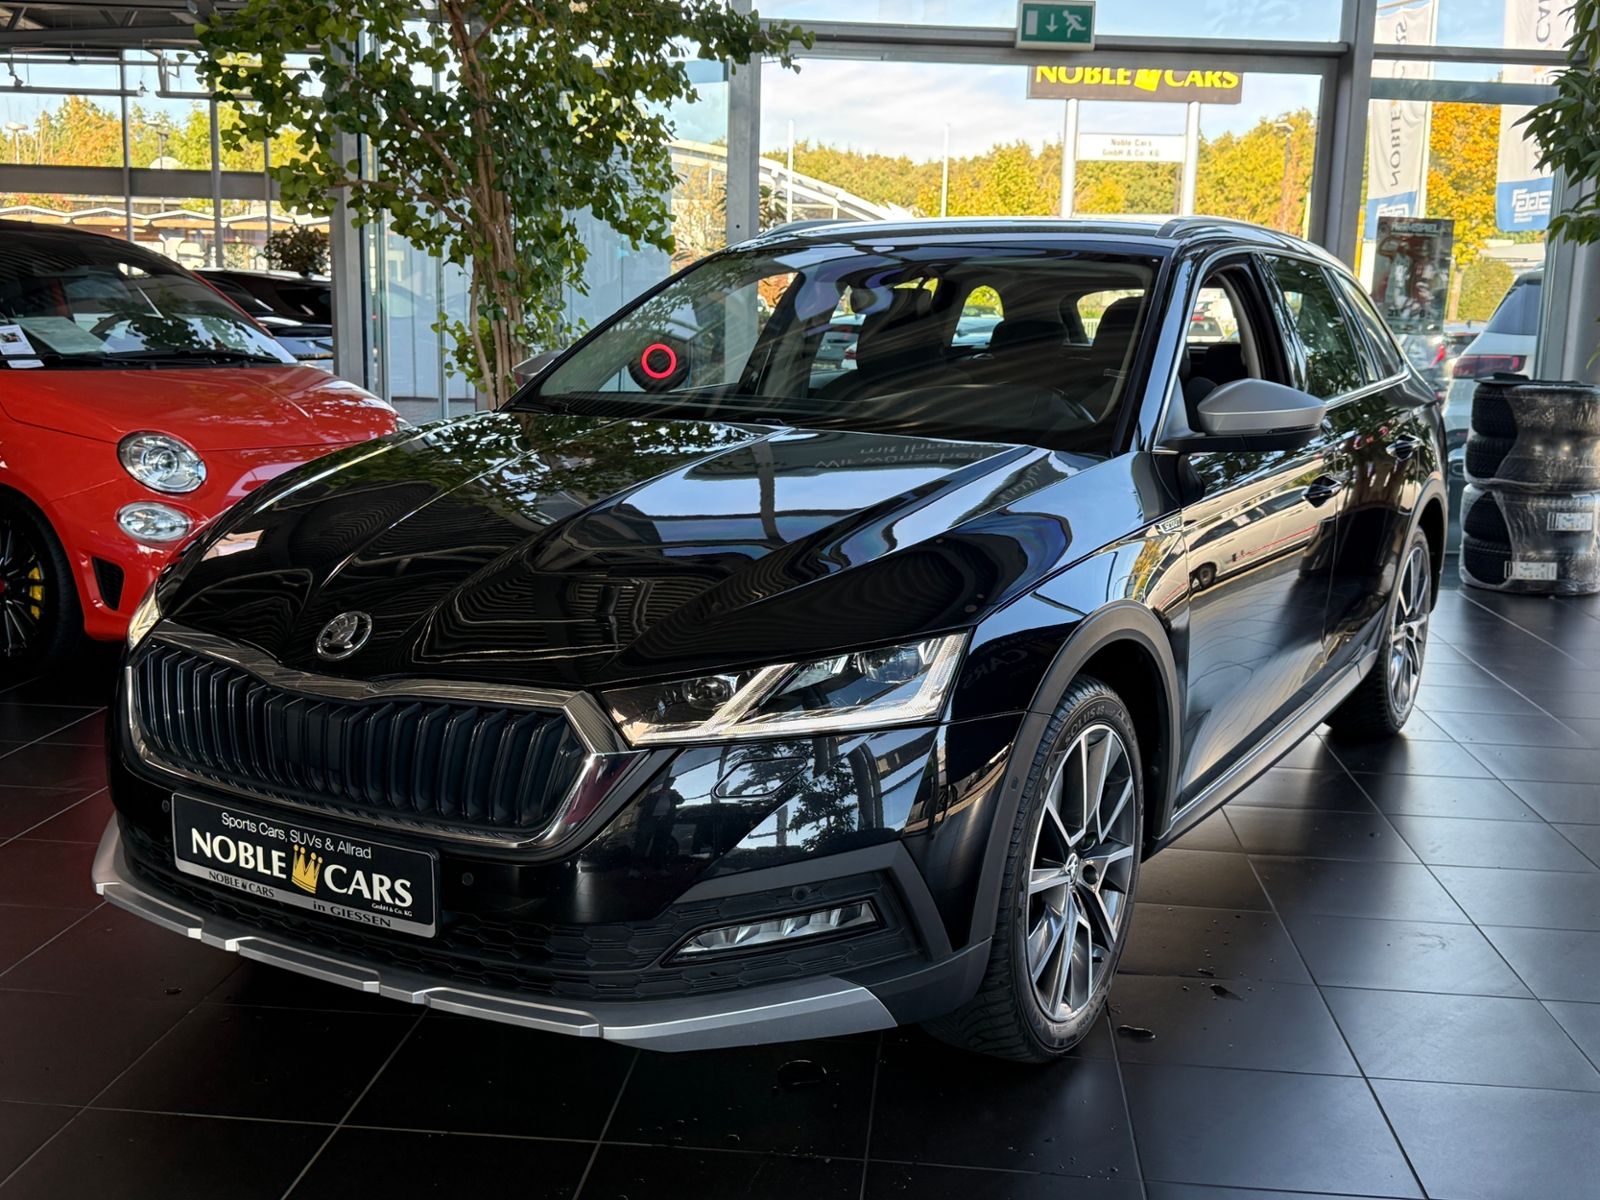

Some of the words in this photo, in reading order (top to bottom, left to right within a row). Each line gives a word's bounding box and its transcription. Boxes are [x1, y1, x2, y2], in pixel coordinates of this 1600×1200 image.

[1036, 65, 1131, 85] NOBLE
[1164, 68, 1239, 89] CARS
[221, 812, 257, 833] Sports
[258, 822, 288, 842] Cars,
[290, 829, 322, 849] SUVs
[325, 838, 334, 851] &
[337, 840, 372, 860] Allrad
[191, 827, 287, 879] NOBLE
[324, 864, 413, 908] CARS
[209, 871, 240, 889] NOBLE
[248, 881, 274, 898] CARS
[313, 901, 325, 912] in
[330, 906, 392, 928] GIESSEN
